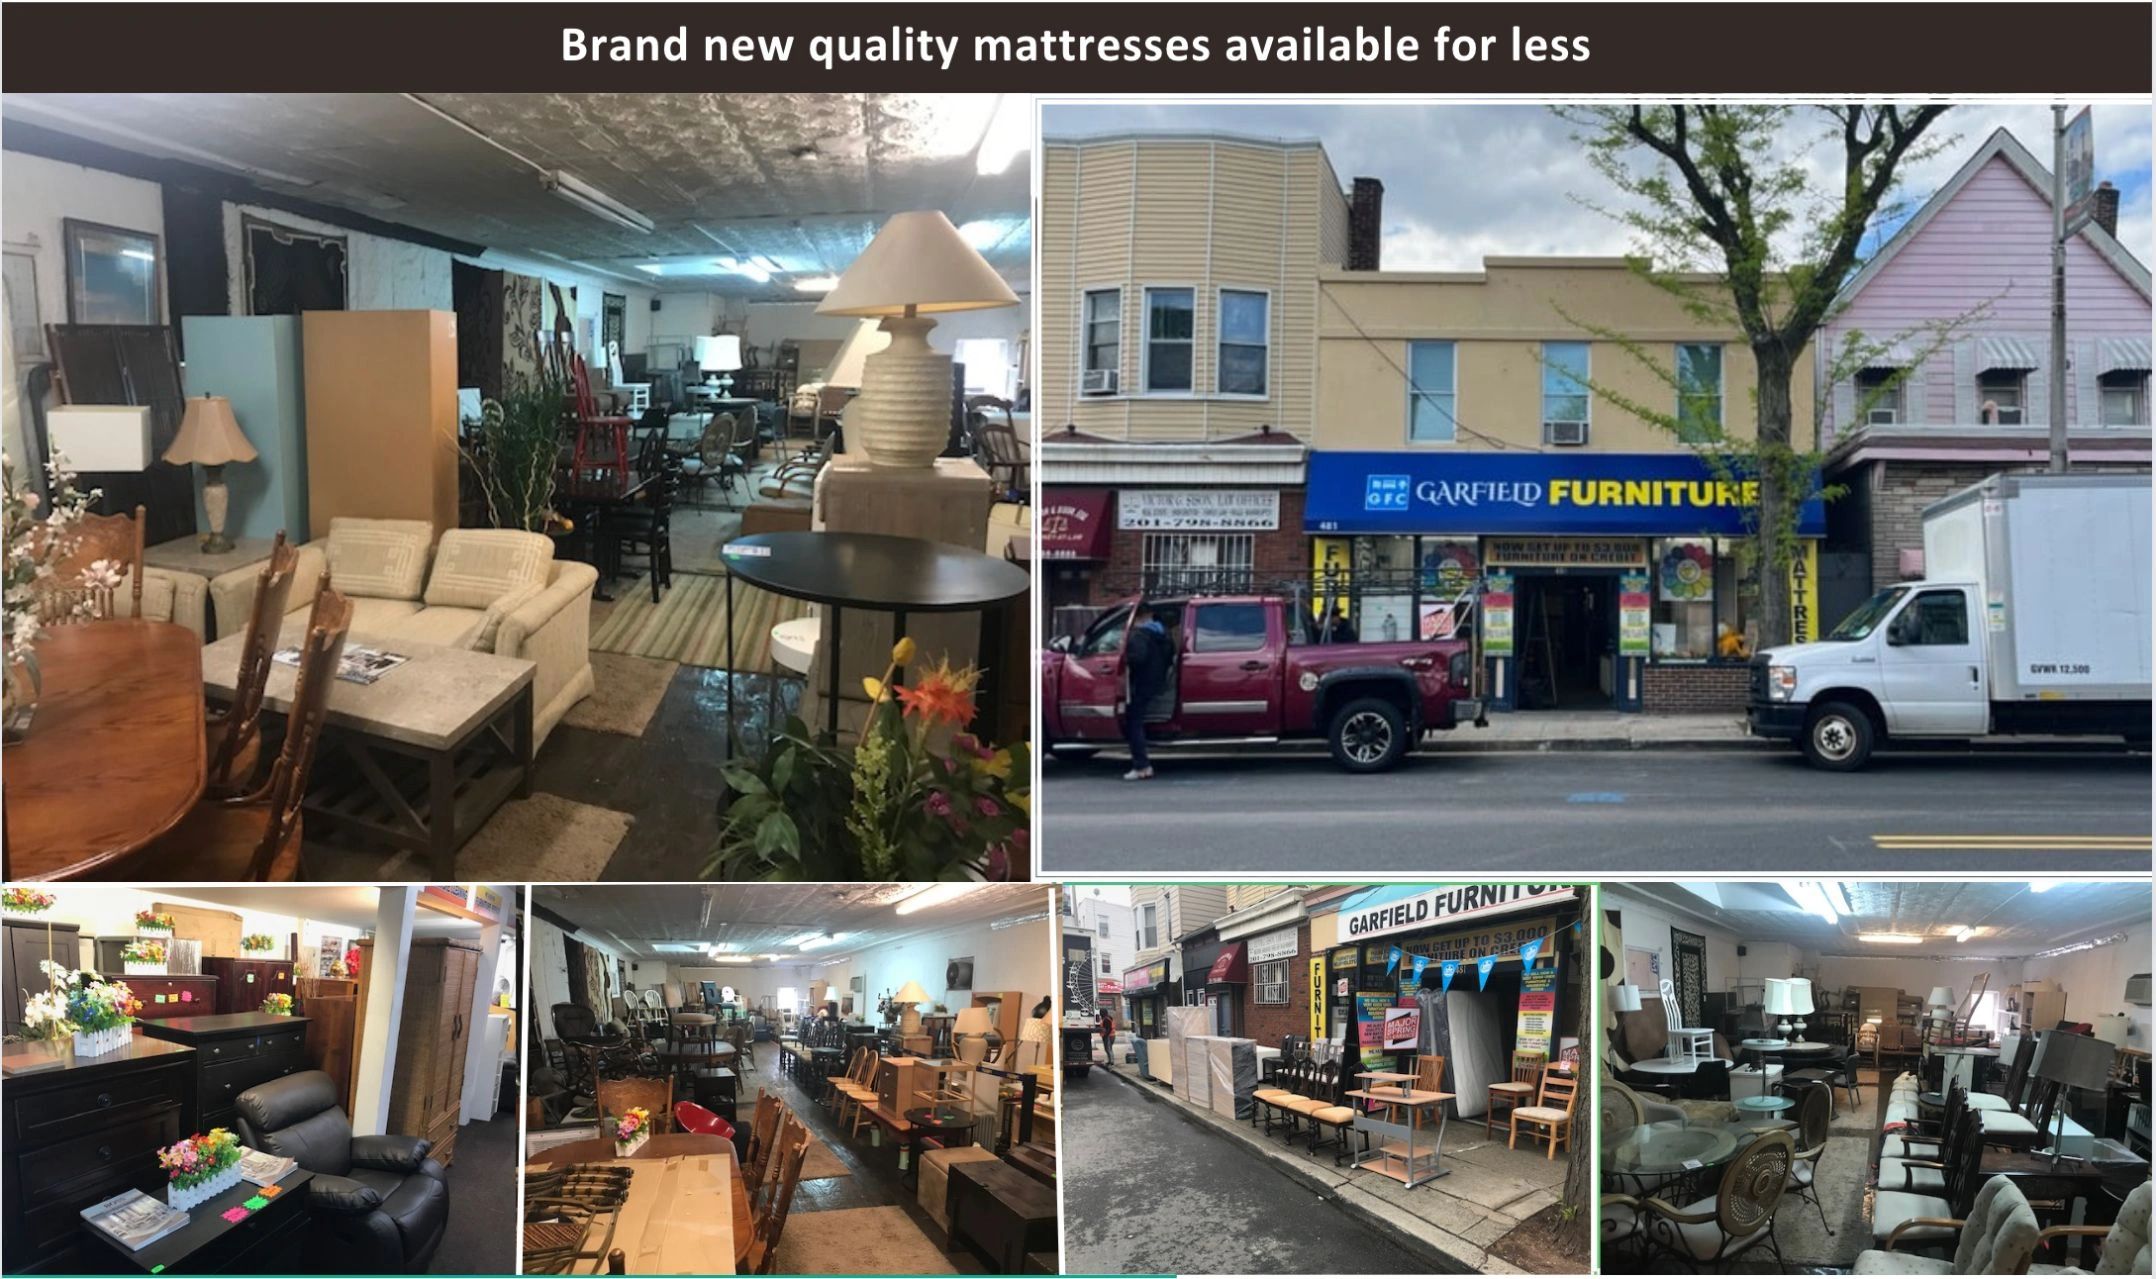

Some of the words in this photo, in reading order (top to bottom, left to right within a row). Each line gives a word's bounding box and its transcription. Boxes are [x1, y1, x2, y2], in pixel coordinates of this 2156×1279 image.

[1368, 492, 1408, 506] GFC
[1415, 481, 1541, 507] GARFIELD
[1549, 479, 1761, 507] FURNITURE
[2031, 664, 2057, 674] GVWR
[1349, 901, 1429, 935] GARFIELD
[1387, 1016, 1417, 1029] MAJOR
[1387, 1025, 1416, 1036] SPRING
